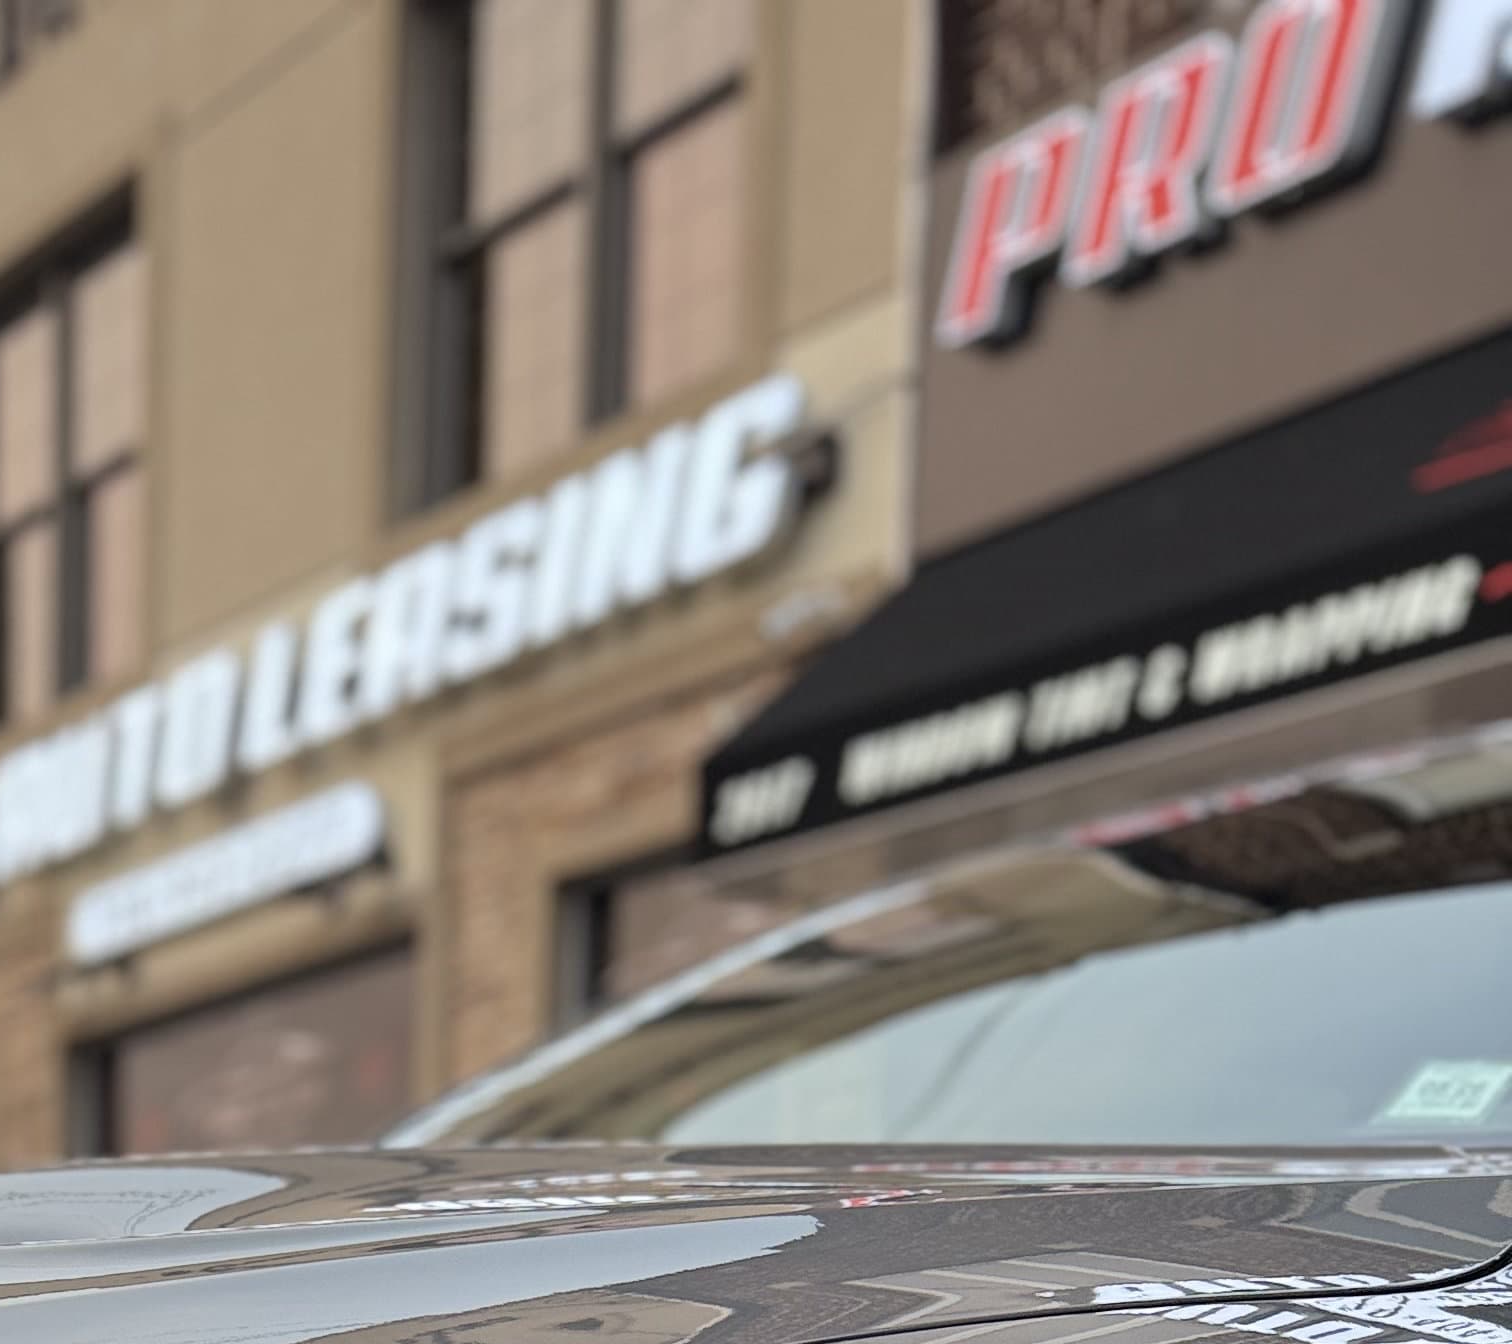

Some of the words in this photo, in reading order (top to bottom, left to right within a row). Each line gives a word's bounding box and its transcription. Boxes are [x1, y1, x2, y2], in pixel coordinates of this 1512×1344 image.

[936, 0, 1380, 348] PRO
[238, 373, 808, 775] LEASING
[1190, 553, 1483, 705] WRAPPING
